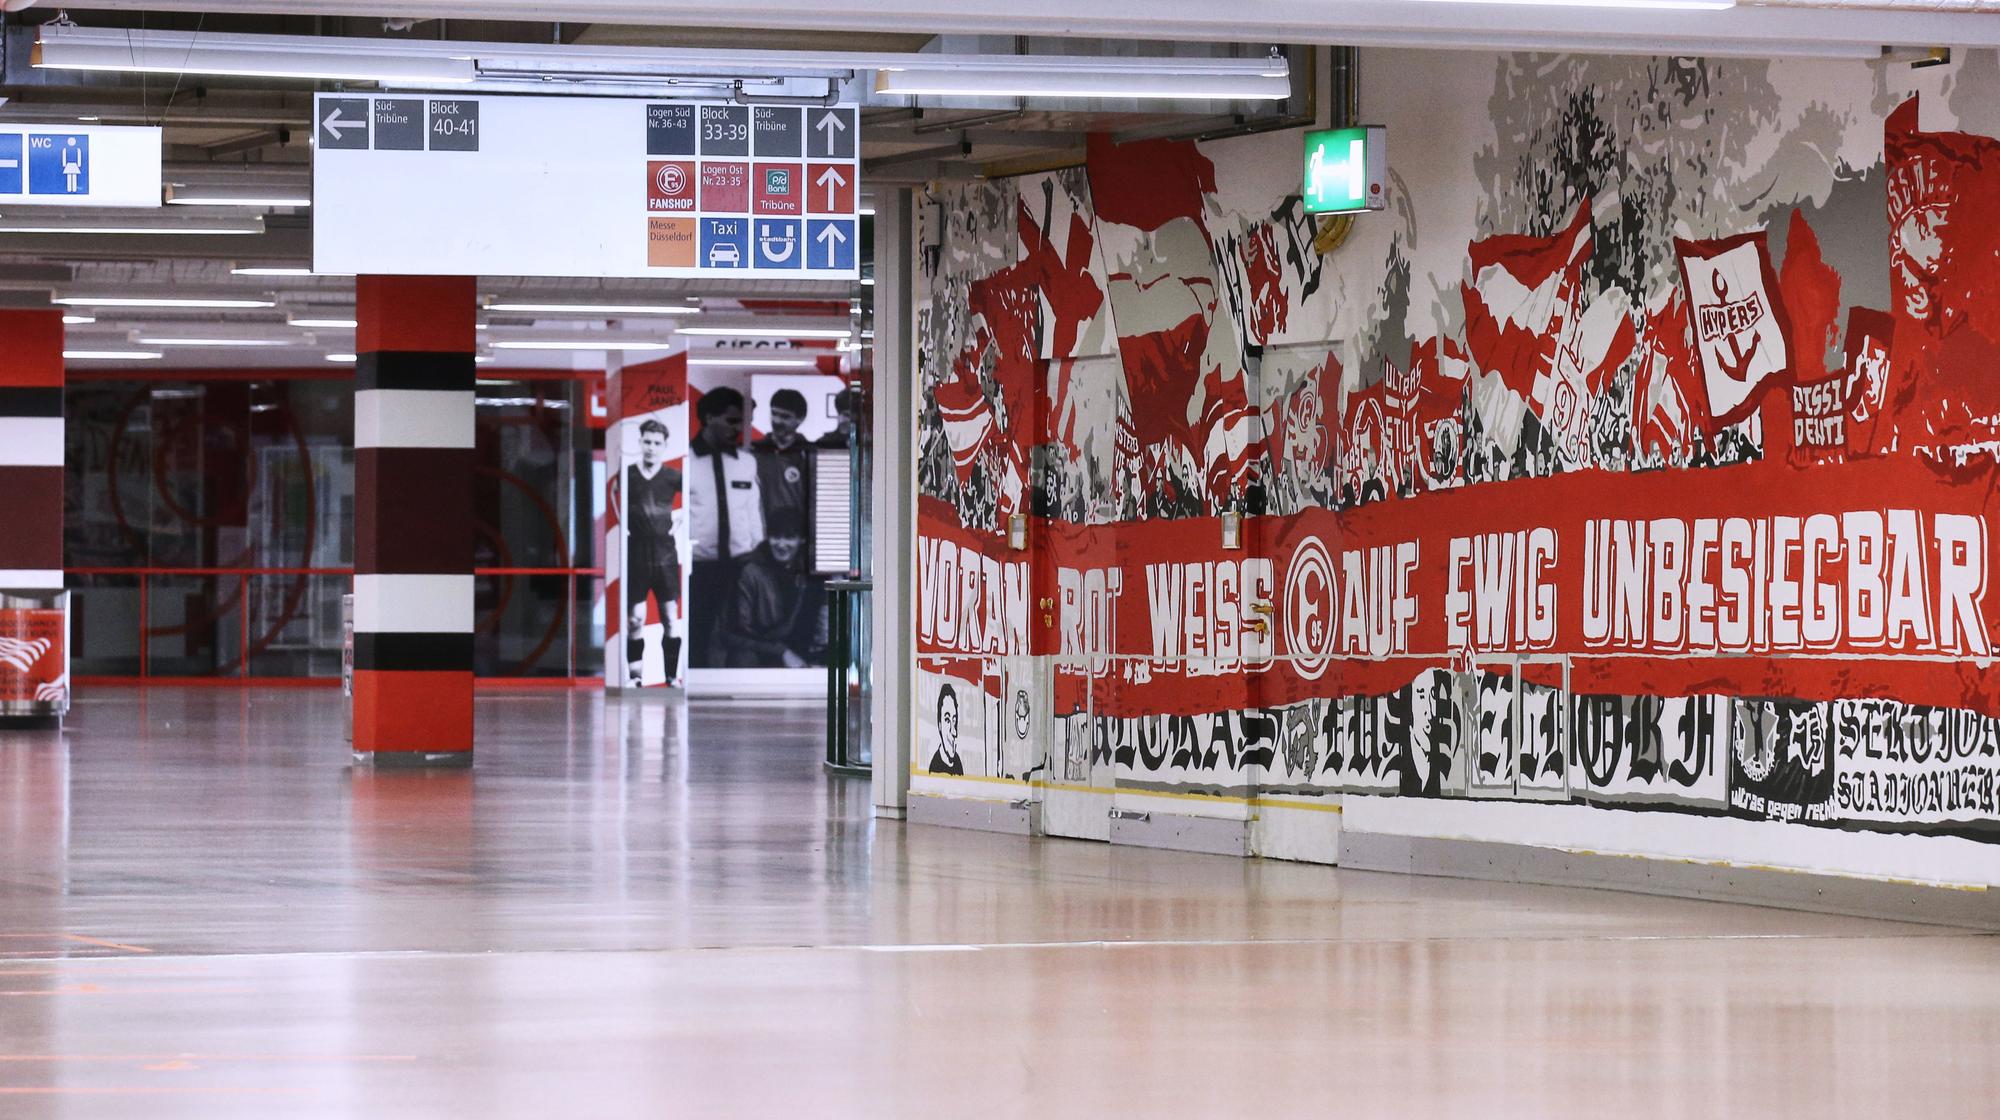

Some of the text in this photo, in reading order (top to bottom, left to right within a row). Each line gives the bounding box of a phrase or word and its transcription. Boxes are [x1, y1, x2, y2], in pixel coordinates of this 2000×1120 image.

[375, 101, 396, 111] Süd-
[430, 101, 460, 115] Block
[375, 113, 408, 124] Tribüne
[648, 107, 691, 119] Logen Süd
[701, 107, 730, 120] Block
[755, 108, 775, 119] Süd-
[433, 118, 475, 136] 40-41
[648, 119, 660, 129] Nr.
[755, 120, 787, 131] Tribüne
[704, 123, 747, 141] 33-39
[31, 137, 52, 149] WC
[702, 165, 743, 176] Logen Ost
[702, 176, 714, 186] Nr.
[767, 184, 787, 193] Bank
[650, 198, 693, 209] FANSHOP
[760, 200, 795, 210] Tribüne
[650, 220, 676, 230] Messe
[711, 221, 737, 235] Taxi
[650, 231, 692, 241] Düsseldorf
[1702, 301, 1758, 337] HYPERS
[1385, 359, 1423, 396] ULTRAS
[1792, 379, 1843, 416] DISSI
[1794, 415, 1845, 446] DENTI
[918, 535, 1031, 656] VORAN
[1057, 566, 1123, 677] ROT
[1145, 557, 1276, 675] WEISS
[1342, 538, 1419, 658] AUF
[1445, 526, 1559, 652] EWIG
[1582, 508, 1991, 656] UNBESIEGBAR
[1837, 765, 2000, 816] STADIONVER
[1731, 787, 1765, 813] ultras
[1766, 800, 1803, 824] gegen
